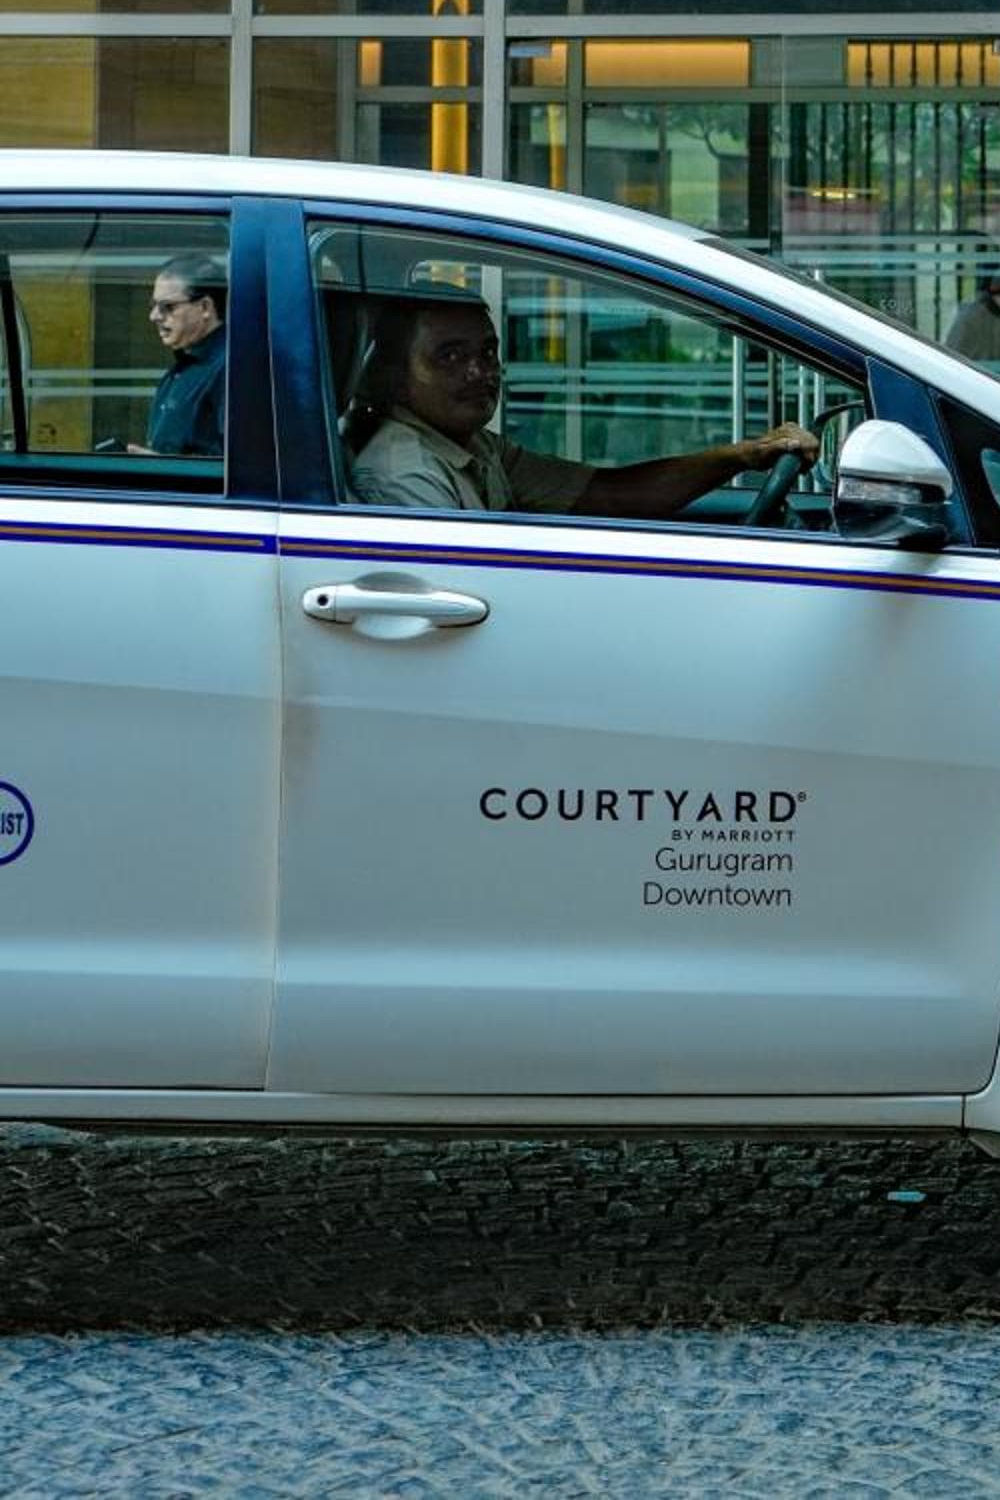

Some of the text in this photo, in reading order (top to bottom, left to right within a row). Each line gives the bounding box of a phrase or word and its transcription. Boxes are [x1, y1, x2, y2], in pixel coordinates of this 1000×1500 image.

[479, 788, 797, 822] COURTYARD
[671, 829, 796, 842] BY MARRIOTT
[655, 847, 793, 877] Gurugram
[643, 881, 792, 907] Downtown
